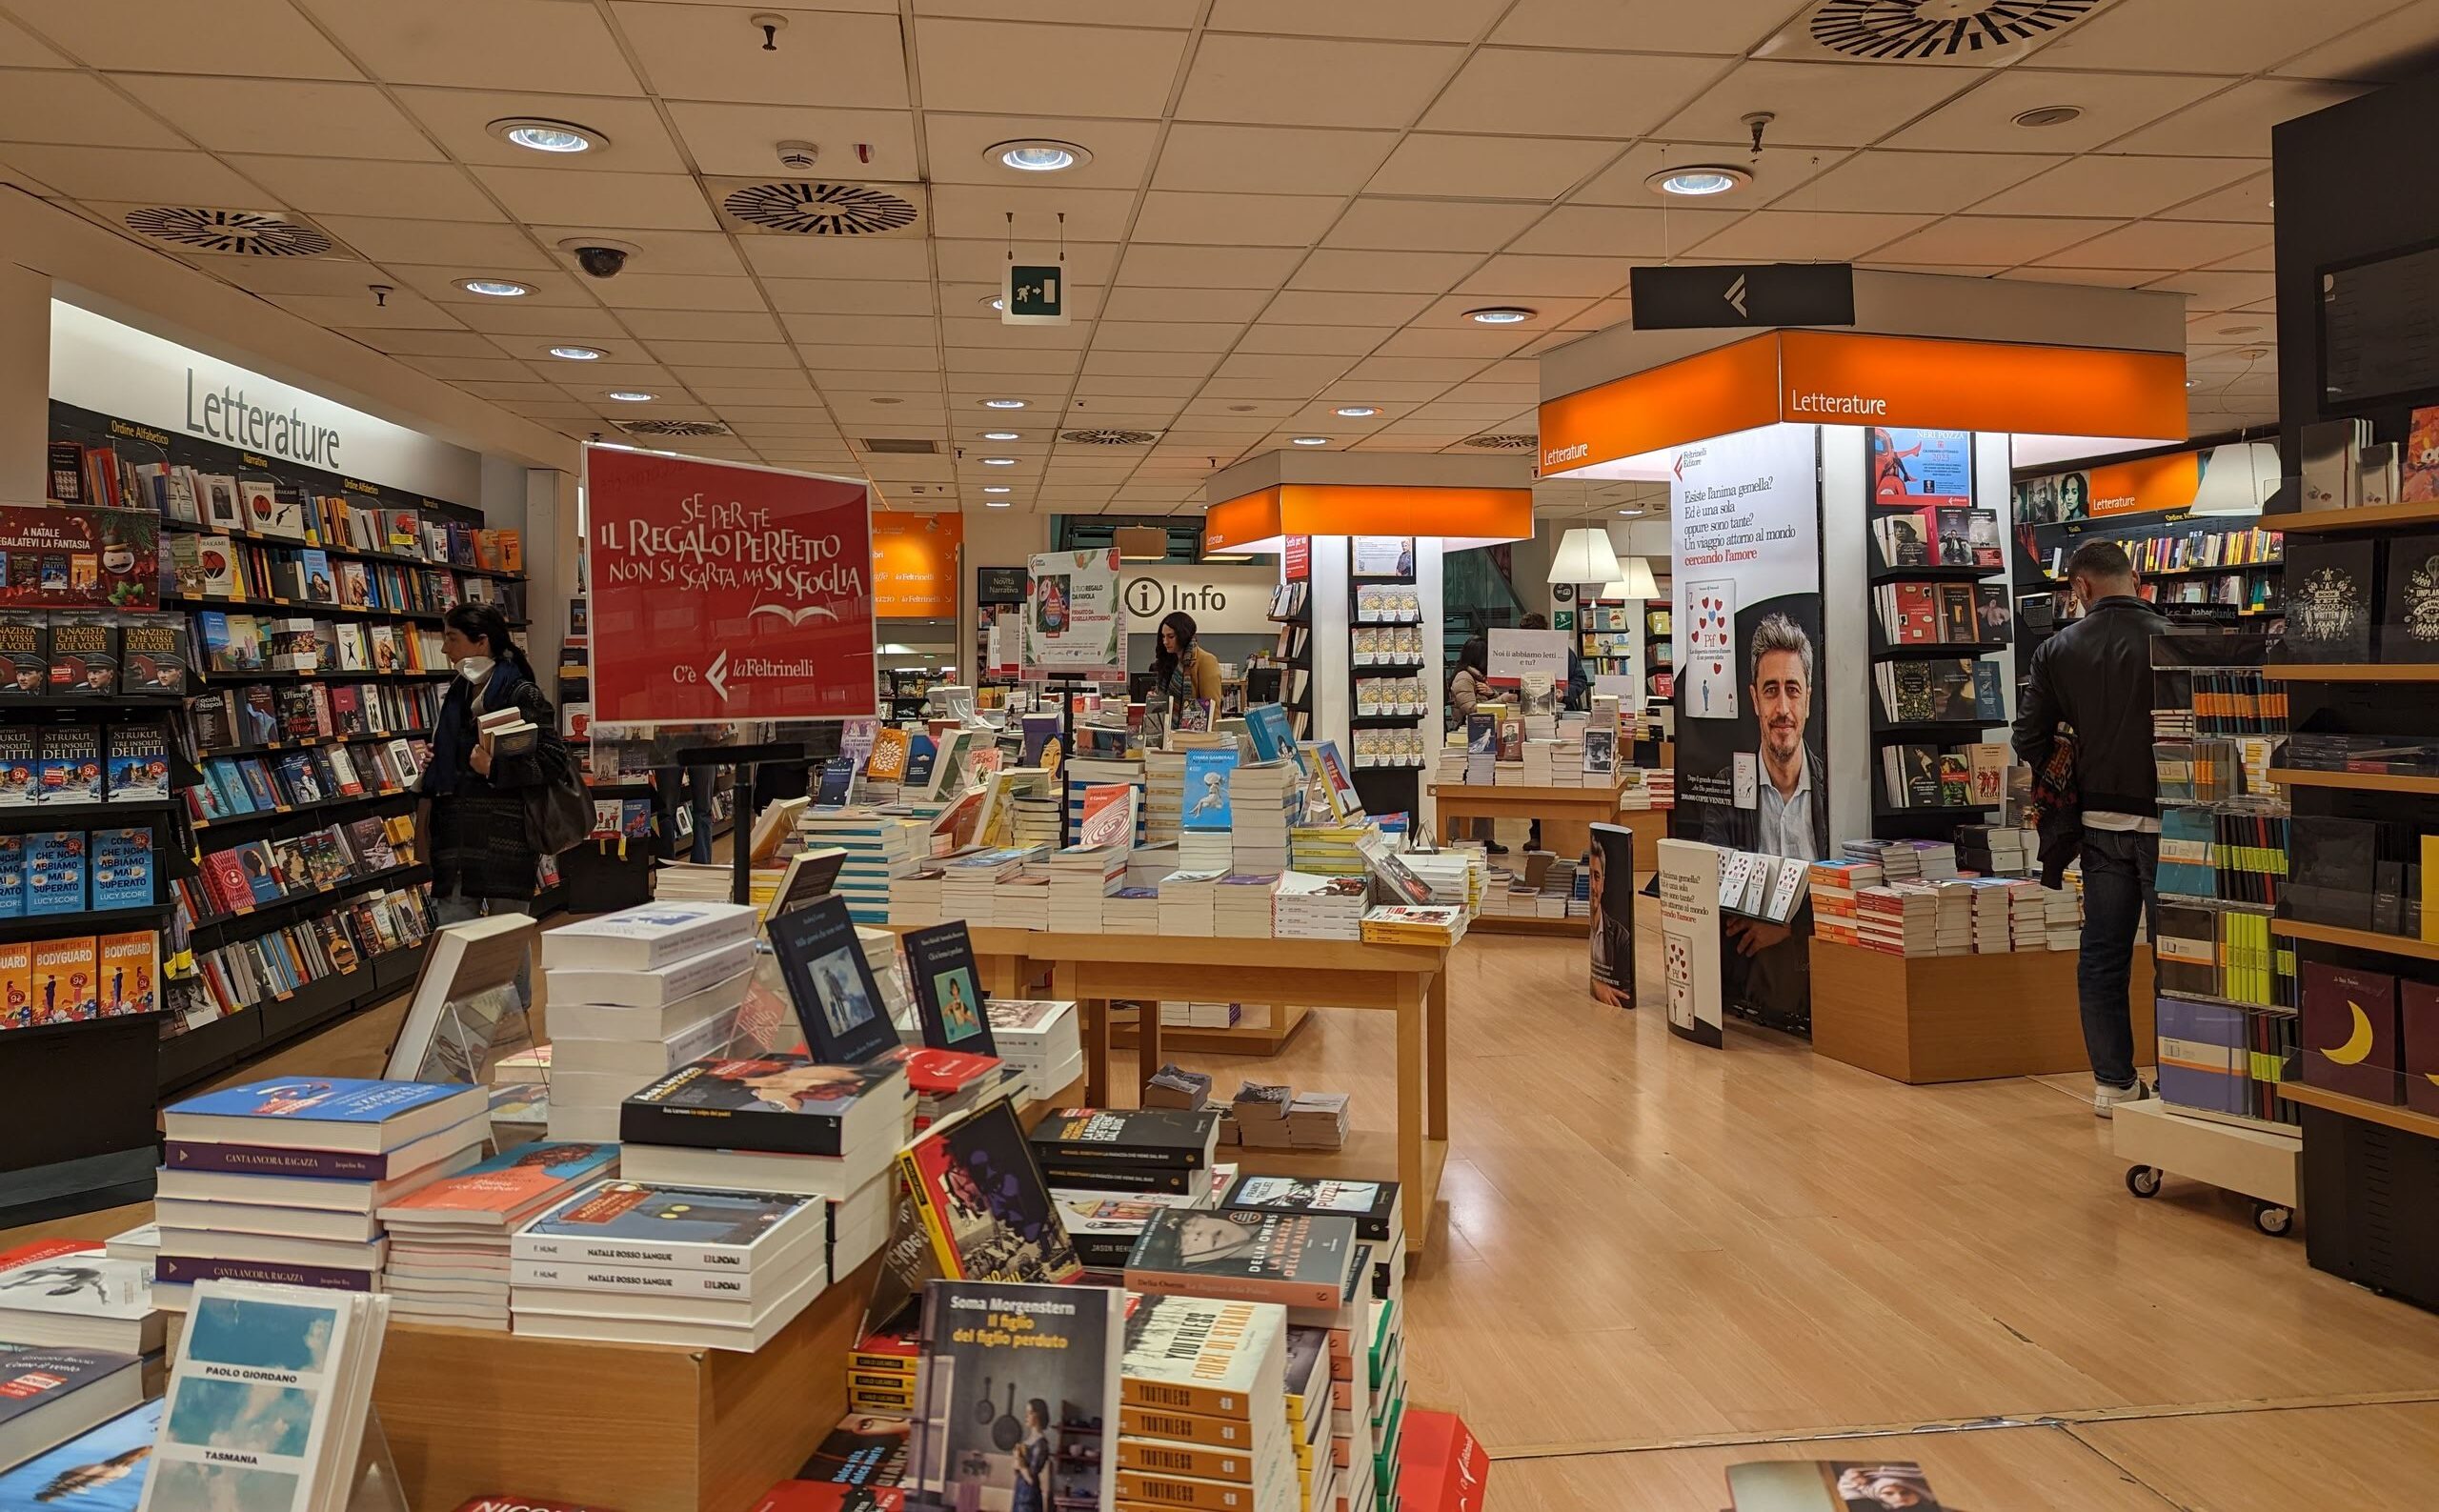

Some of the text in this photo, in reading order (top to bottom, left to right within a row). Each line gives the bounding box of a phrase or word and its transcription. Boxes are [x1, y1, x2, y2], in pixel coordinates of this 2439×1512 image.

[1793, 390, 1885, 414] Letterature
[186, 368, 340, 469] Letterature
[111, 420, 169, 446] Ordine Alfabetico
[1544, 442, 1588, 465] Letterature
[1684, 475, 1773, 504] Esiste l'anima gemella?
[1684, 501, 1735, 519] Ed è una sola
[2093, 496, 2135, 511] Letterature
[681, 493, 771, 532] SE PER TE
[1684, 513, 1754, 535] oppure sono tante?
[23, 527, 60, 538] A NATALE
[1684, 525, 1796, 551] Un viaggio attorno al mondo
[41, 538, 91, 550] LA FANTASIA
[601, 519, 840, 566] IL REGALO PERFETTO
[1684, 548, 1757, 566] cercando l'amore
[609, 557, 863, 601] NON SI SCARTA, MA SI SFOGLIA
[1172, 584, 1226, 611] Info
[56, 626, 107, 635] IL NAZISTA
[127, 628, 174, 636] IL NAZISTA
[8, 642, 36, 651] VOLTE
[55, 642, 107, 651] DUE VOLTE
[1703, 634, 1716, 647] Pif
[1512, 650, 1542, 658] abbiamo
[673, 665, 697, 683] C'è
[199, 700, 224, 709] Napoli
[44, 733, 94, 741] STRUKUL
[113, 731, 162, 739] STRUKUL
[42, 748, 96, 760] DELITTI
[111, 746, 164, 757] DELITTI
[1708, 796, 1732, 806] VENDUTE
[101, 848, 120, 857] CHE
[35, 861, 77, 871] ABBIAMO
[101, 857, 145, 867] ABBIAMO
[48, 872, 65, 881] MAI
[113, 868, 132, 877] MAI
[33, 883, 79, 894] SUPERATO
[99, 878, 147, 890] SUPERATO
[33, 897, 53, 905] LUCY
[99, 890, 147, 900] LUCY SCORE
[1690, 907, 1709, 916] mondo
[36, 949, 92, 966] BODYGUARD
[104, 942, 151, 958] BODYGUARD
[226, 1154, 318, 1168] CANTA ANCORA, RAGAZZA
[1317, 1181, 1341, 1207] PUZZLE
[1248, 1214, 1279, 1273] DELIA OWENS
[1266, 1218, 1294, 1270] LA RAGAZZA
[1283, 1215, 1312, 1277] DELLA PALUDE
[534, 1244, 539, 1253] F.
[588, 1248, 614, 1257] NATALE
[616, 1250, 640, 1259] ROSSO
[642, 1252, 673, 1261] SANGUE
[213, 1267, 304, 1283] CANTA ANCORA, RAGAZZA
[534, 1269, 673, 1287] F. HUME NATALE ROSSO SANGUE
[950, 1296, 1076, 1316] Soma Morgenstern
[987, 1314, 1036, 1331] Il figlio
[1211, 1304, 1256, 1338] STRADA
[977, 1330, 1010, 1347] figlio
[1012, 1333, 1069, 1349] perduto
[1163, 1312, 1217, 1361] YOUTHLESS
[1204, 1340, 1238, 1350] DI
[205, 1365, 297, 1384] PAOLO GIORDANO
[1191, 1353, 1232, 1381] FIORI
[204, 1450, 257, 1465] TASMANIA
[850, 1446, 885, 1484] dolce morte
[832, 1449, 868, 1483] Dolce vita,
